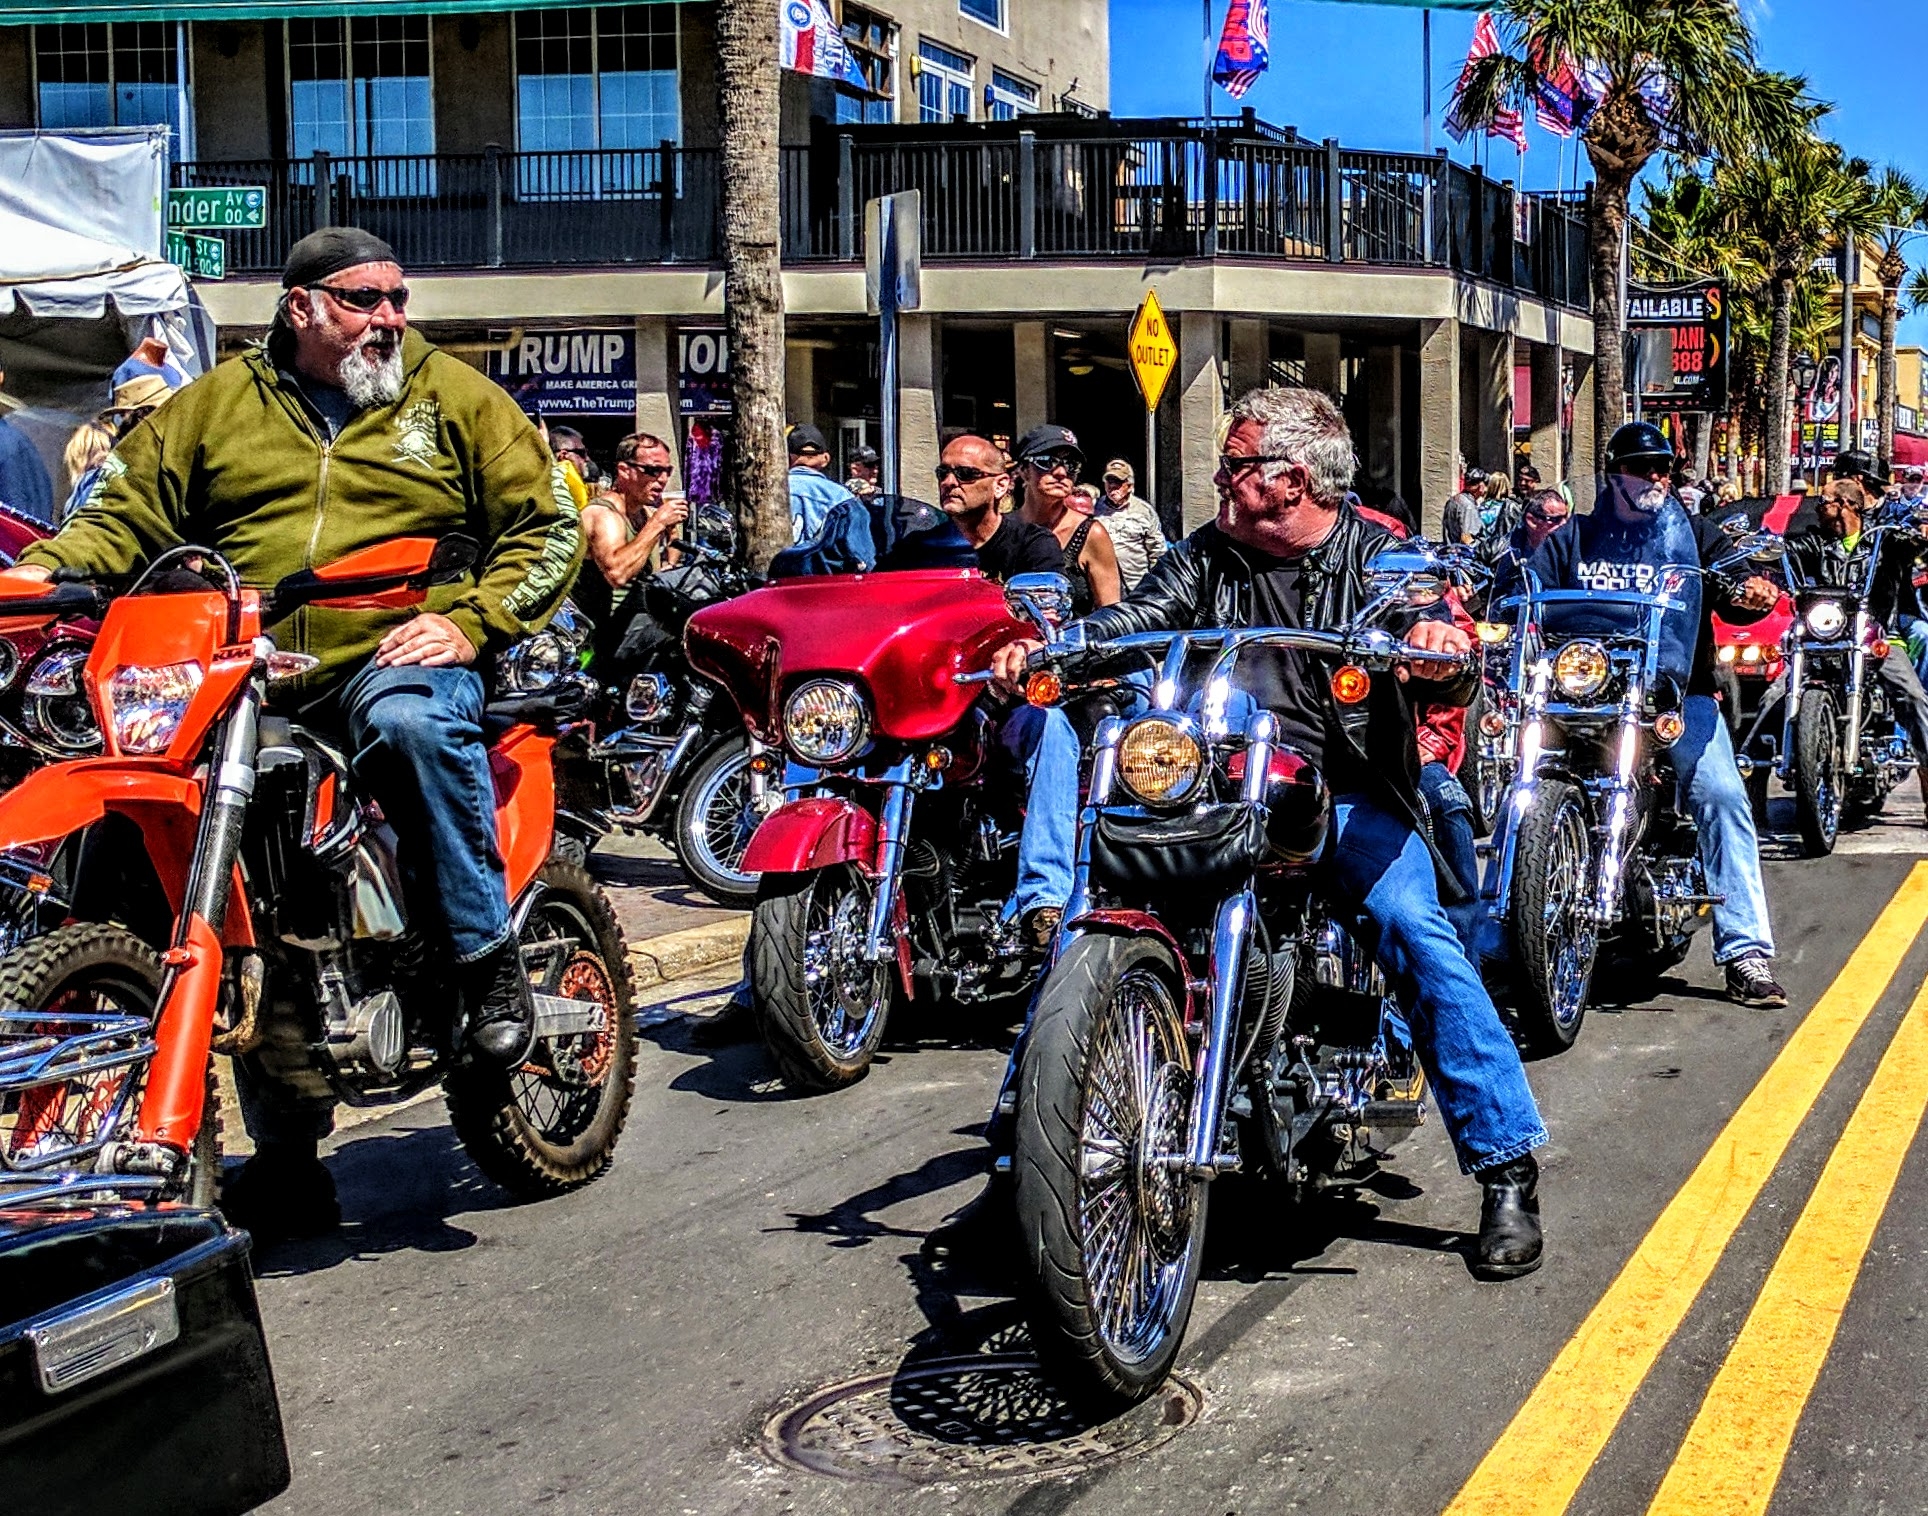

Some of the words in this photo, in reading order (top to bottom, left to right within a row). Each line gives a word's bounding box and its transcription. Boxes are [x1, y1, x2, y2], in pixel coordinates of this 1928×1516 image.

[225, 191, 243, 206] Av
[195, 240, 208, 256] St
[1146, 318, 1159, 337] NO
[1136, 344, 1169, 367] OUTLET
[545, 380, 574, 389] MAKE
[575, 380, 619, 389] AMERICA
[1577, 560, 1654, 580] MATCO
[212, 648, 251, 662] KTM
